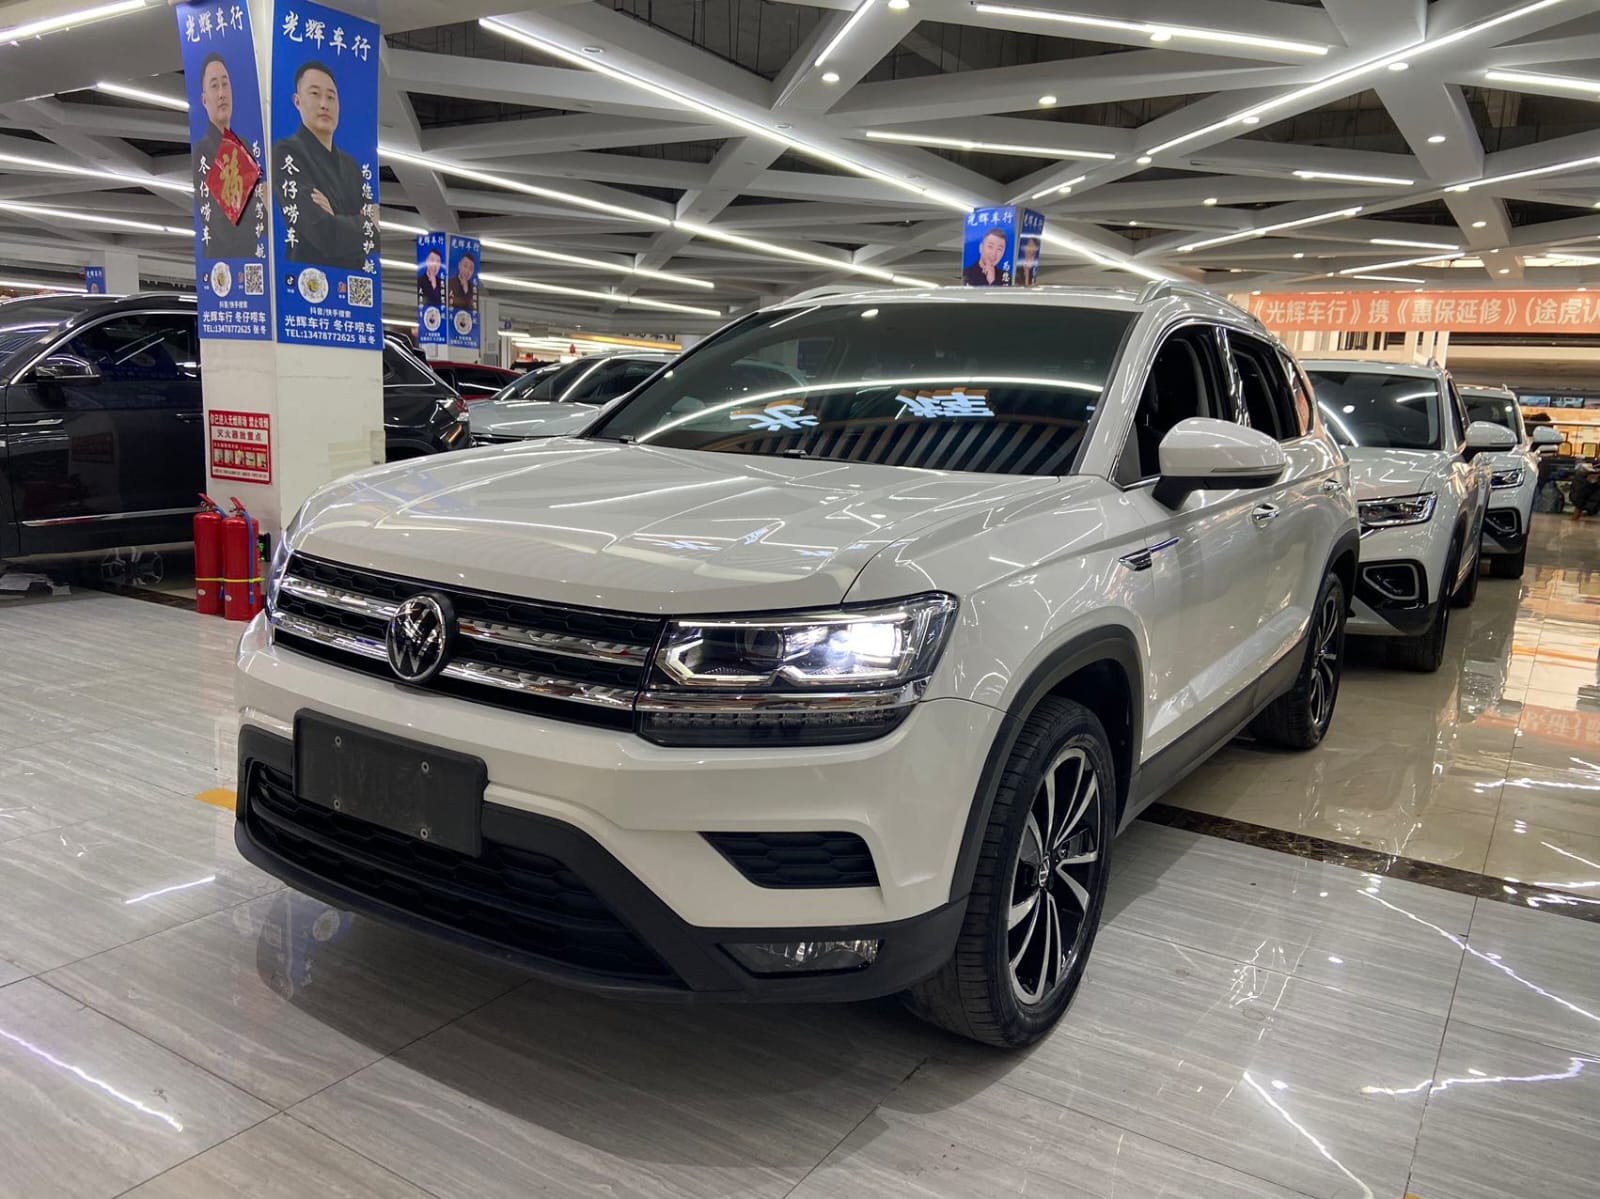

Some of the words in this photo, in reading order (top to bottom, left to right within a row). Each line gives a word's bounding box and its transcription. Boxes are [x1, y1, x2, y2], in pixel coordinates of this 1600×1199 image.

[185, 6, 244, 42] 光辉车行
[282, 10, 371, 61] 光辉车行
[220, 148, 244, 210] 福
[252, 140, 266, 259] 为保驾护航
[280, 154, 300, 248] 冬仔唠车
[361, 163, 377, 274] 为您保驾护航
[284, 314, 329, 330] 光辉车行
[333, 319, 375, 335] 冬仔唠车
[358, 335, 376, 345] 张冬
